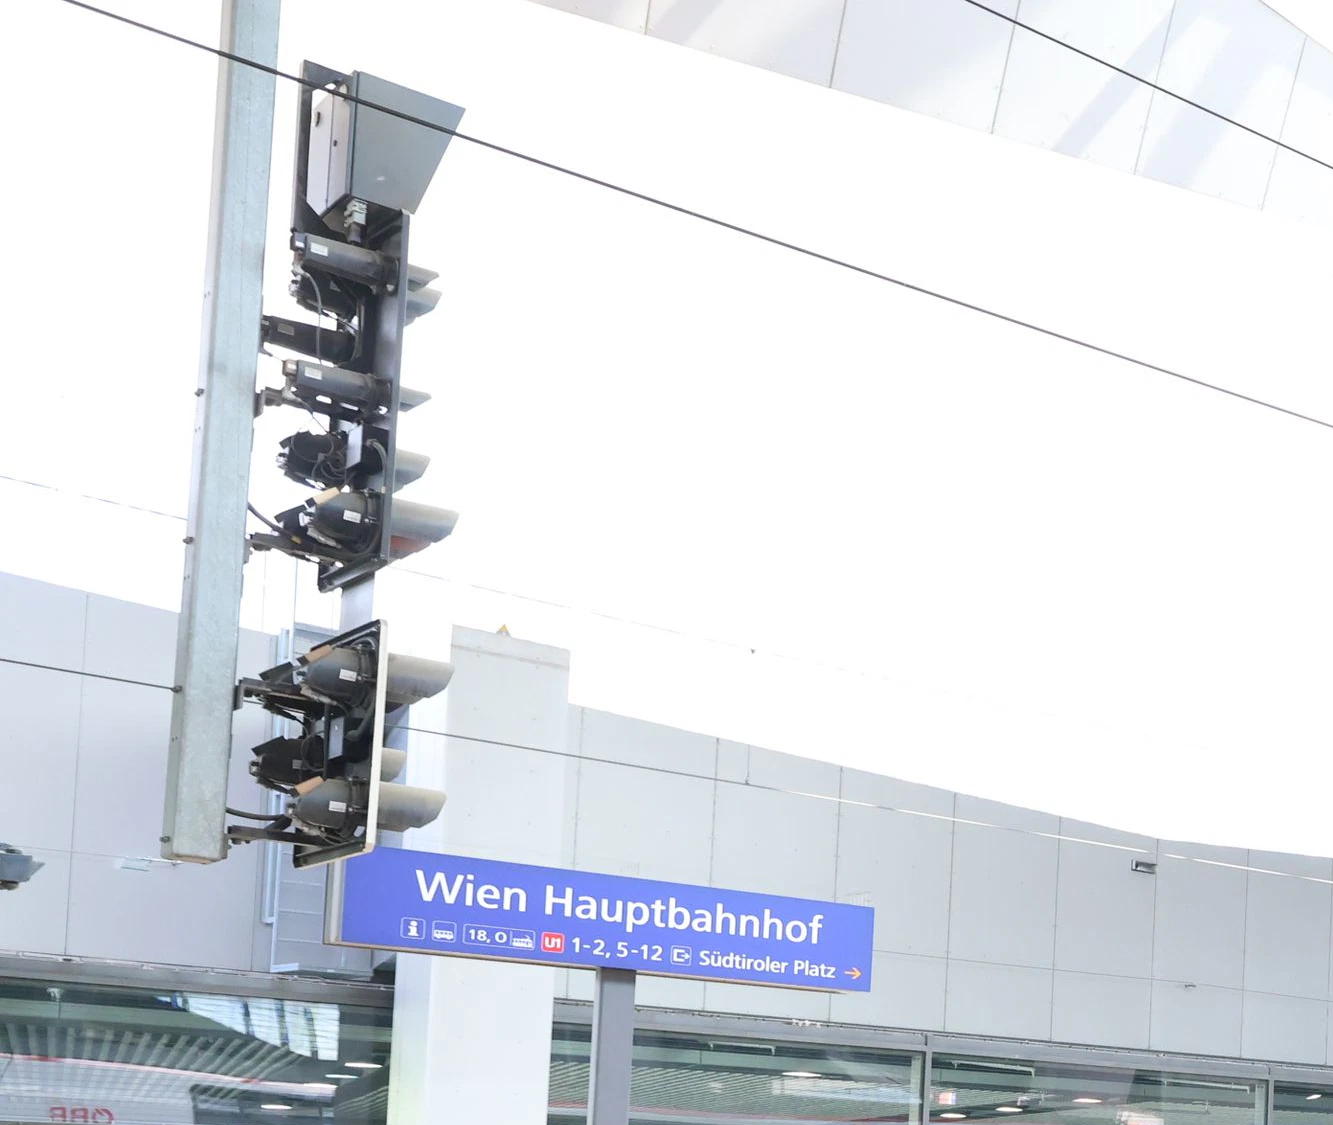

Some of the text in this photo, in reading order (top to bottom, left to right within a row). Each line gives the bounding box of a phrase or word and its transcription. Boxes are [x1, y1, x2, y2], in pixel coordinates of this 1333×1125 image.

[415, 869, 822, 945] Wien Hauptbahnhof
[468, 929, 491, 943] 18,
[544, 936, 561, 949] U1
[572, 937, 611, 959] 1-2,
[616, 941, 663, 961] 5-12
[699, 950, 788, 973] Südtiroler
[794, 960, 836, 978] Platz
